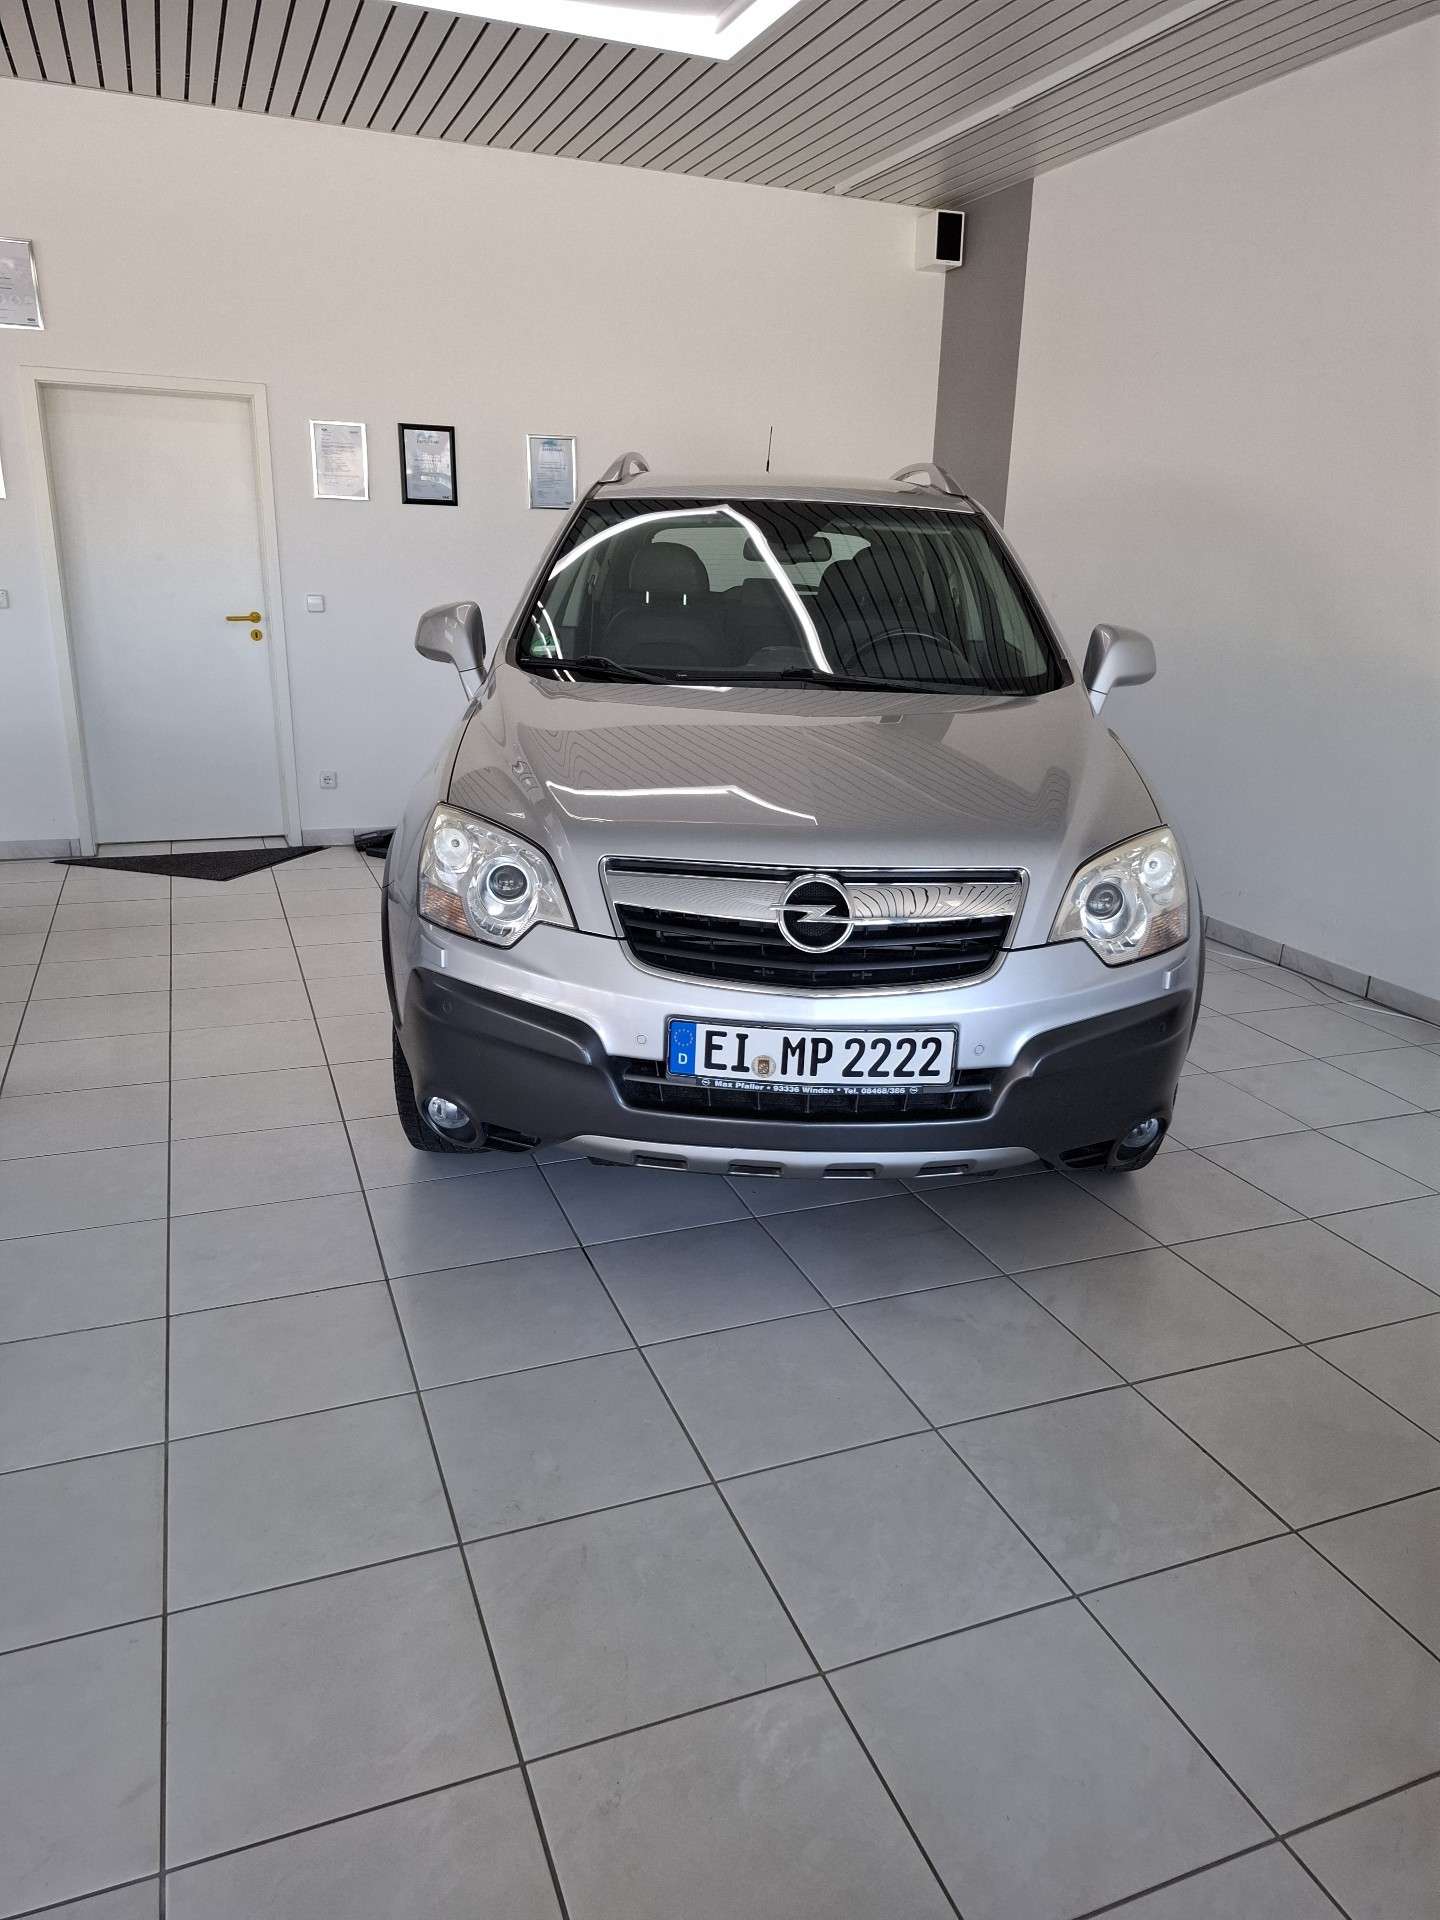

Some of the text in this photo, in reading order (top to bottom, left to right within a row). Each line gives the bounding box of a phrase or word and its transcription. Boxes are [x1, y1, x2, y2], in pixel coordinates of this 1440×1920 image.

[678, 1053, 688, 1065] D
[704, 1030, 943, 1078] EI MP 2222
[714, 1080, 733, 1088] Max
[773, 1085, 800, 1093] 93336
[802, 1086, 834, 1094] Winden
